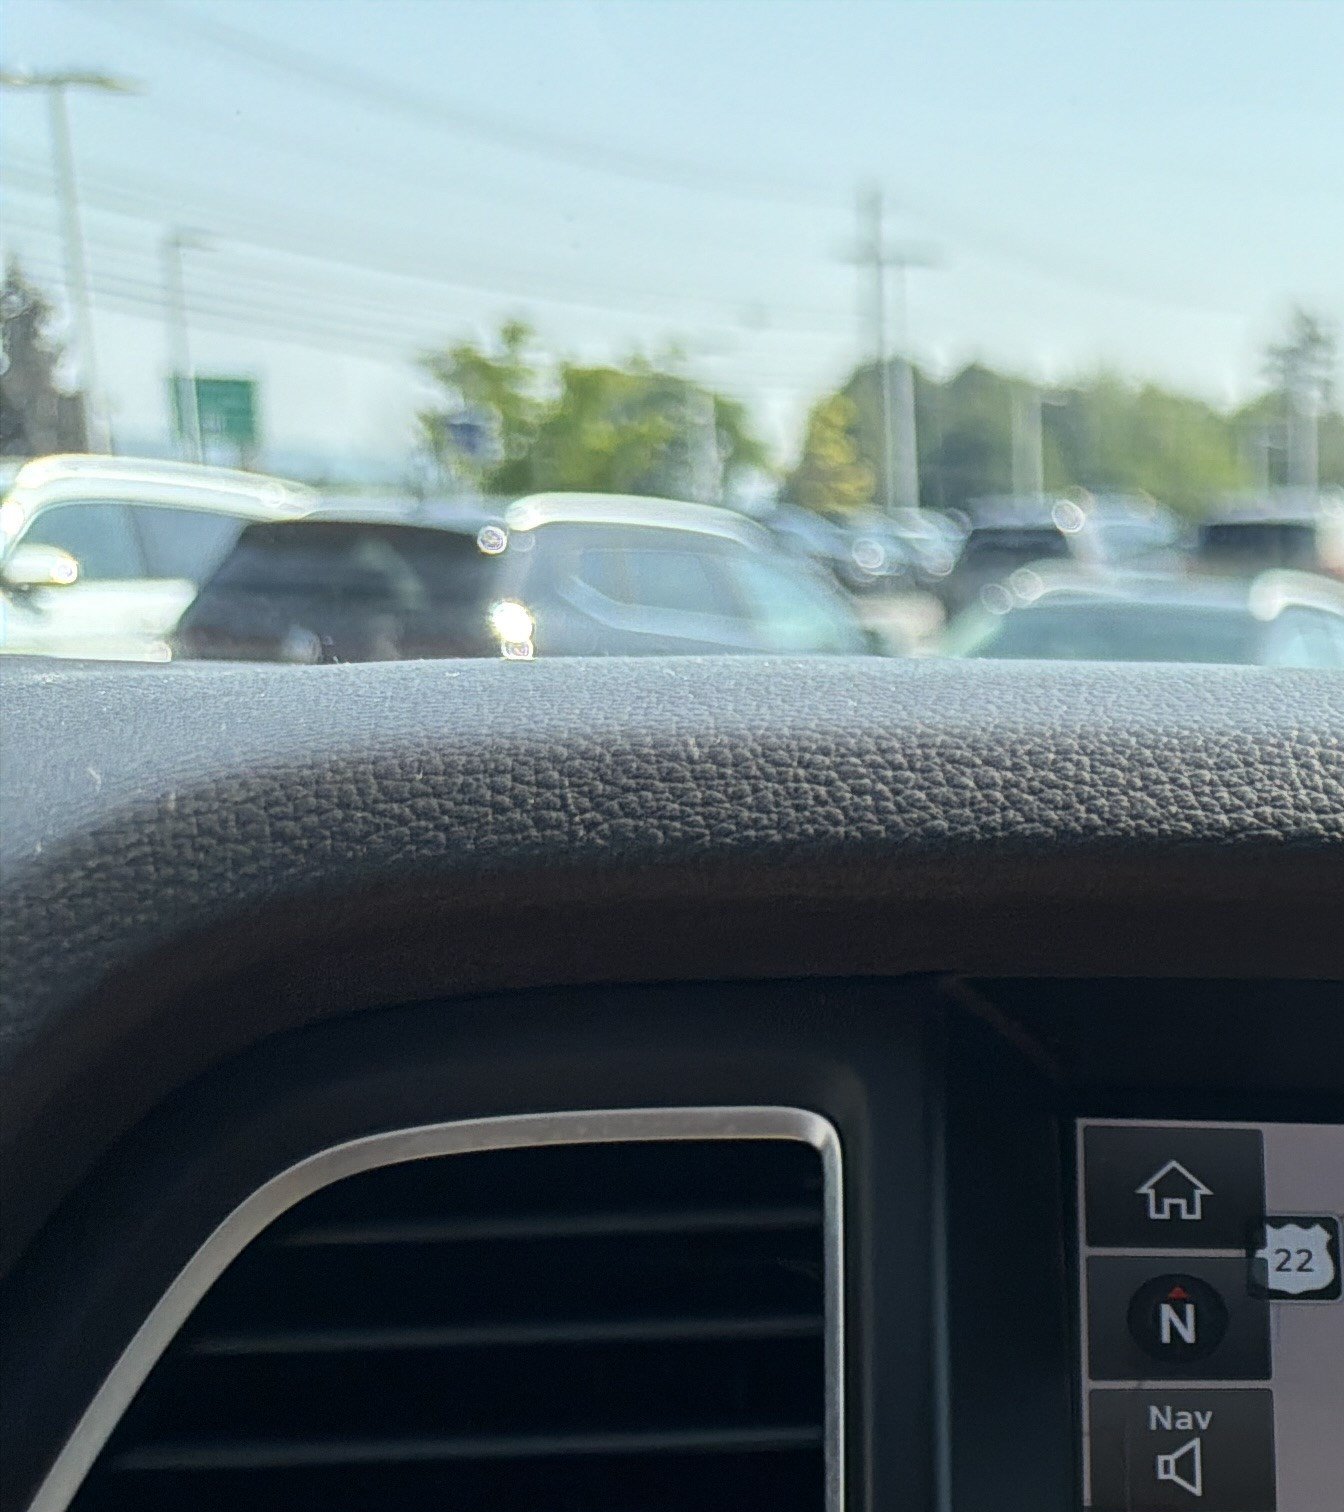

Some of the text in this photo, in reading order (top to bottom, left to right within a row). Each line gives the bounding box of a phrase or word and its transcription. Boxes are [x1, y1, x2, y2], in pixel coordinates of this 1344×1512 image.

[1274, 1246, 1315, 1274] 22
[1160, 1302, 1197, 1345] N
[1149, 1405, 1213, 1432] Nav
